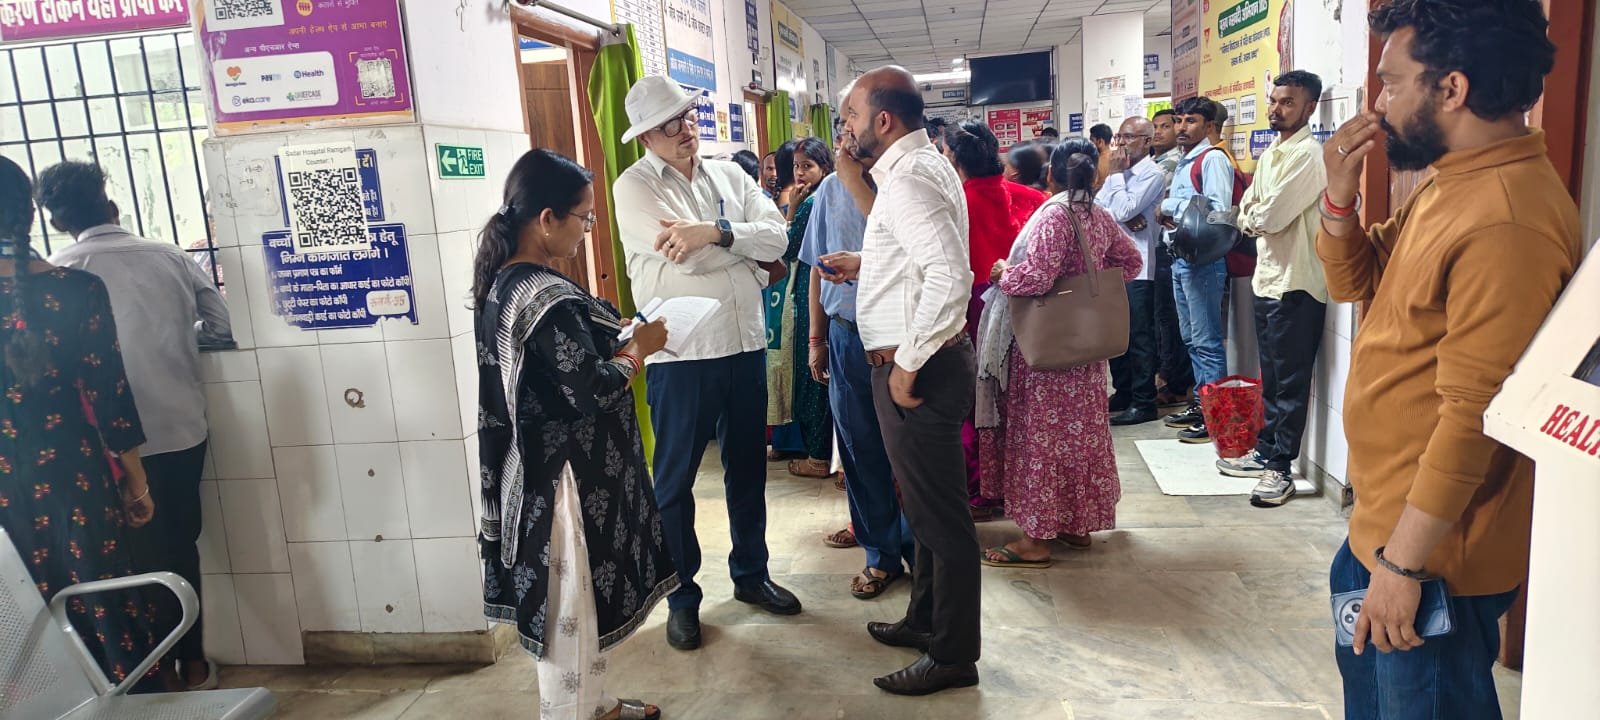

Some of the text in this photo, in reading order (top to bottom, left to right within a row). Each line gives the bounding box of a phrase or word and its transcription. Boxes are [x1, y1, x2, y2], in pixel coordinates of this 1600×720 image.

[467, 149, 483, 161] FIRE
[469, 163, 483, 175] EXIT
[1540, 404, 1600, 456] HEAL
